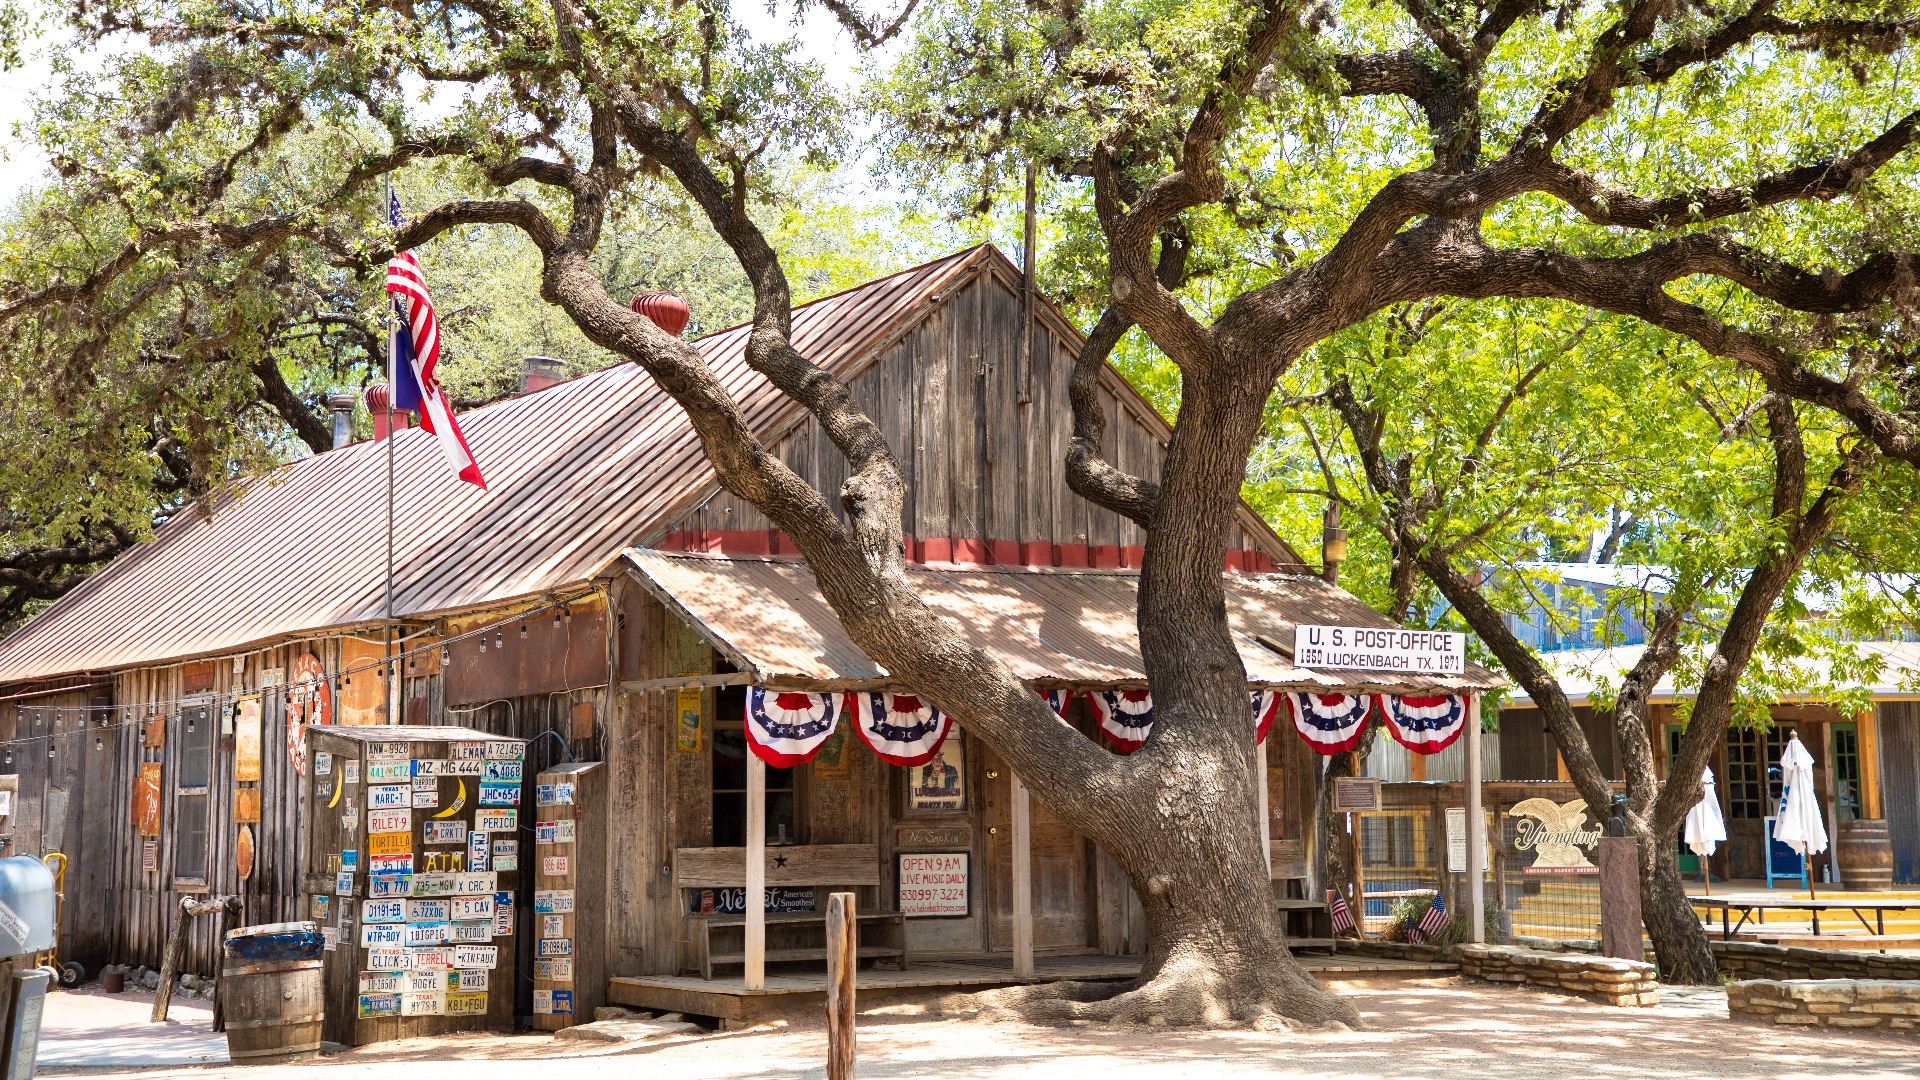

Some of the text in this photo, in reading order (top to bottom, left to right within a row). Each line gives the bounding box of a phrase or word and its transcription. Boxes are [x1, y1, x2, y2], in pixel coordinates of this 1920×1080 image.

[1309, 627, 1452, 652] U. S. POST-OFFICE
[1300, 648, 1459, 670] 1850 LUCKENBACH TX. 1971
[418, 762, 480, 774] MZ MG 444
[482, 789, 518, 800] JHC 654
[1514, 819, 1604, 850] Yuengling
[372, 835, 410, 849] TORTILLA
[426, 852, 461, 872] ATM
[903, 858, 960, 871] OPEN 9 AM
[468, 880, 484, 891] CRC
[901, 874, 966, 885] LIVE MUSIC DAILY
[394, 881, 408, 893] 770
[416, 881, 430, 891] 735
[715, 887, 780, 912] Veet
[465, 901, 489, 913] 5 CAV
[417, 953, 451, 965] TERRELL
